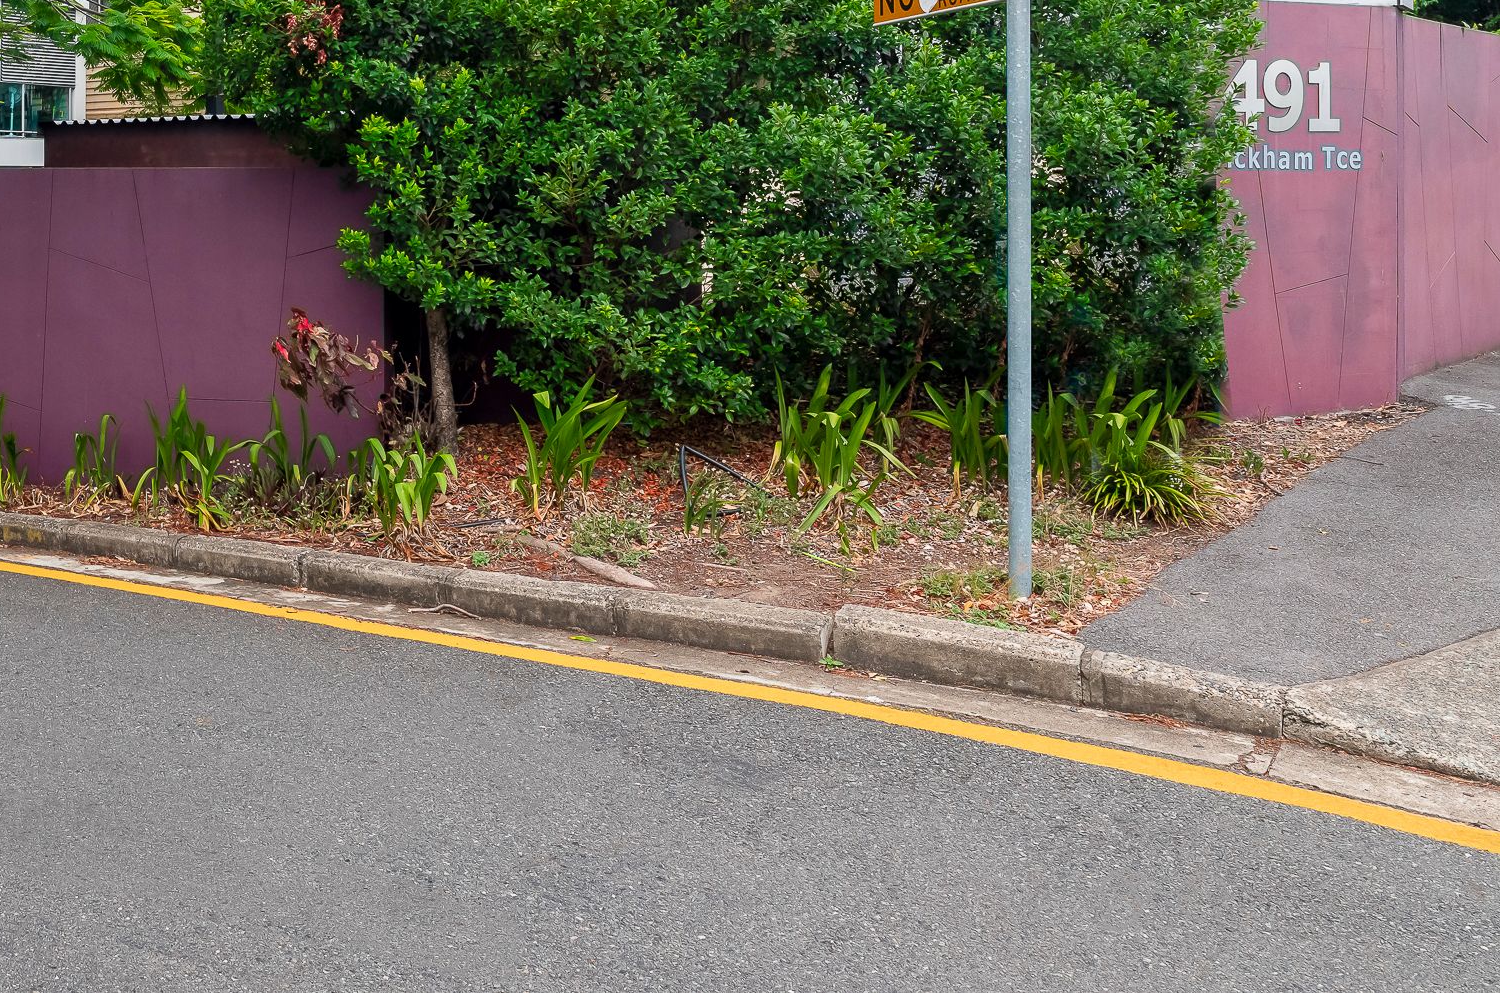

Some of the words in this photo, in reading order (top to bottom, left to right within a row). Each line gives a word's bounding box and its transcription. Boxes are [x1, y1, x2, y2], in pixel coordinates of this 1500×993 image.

[1220, 59, 1341, 132] 491
[1227, 144, 1313, 170] ckham
[1321, 146, 1361, 169] Tce
